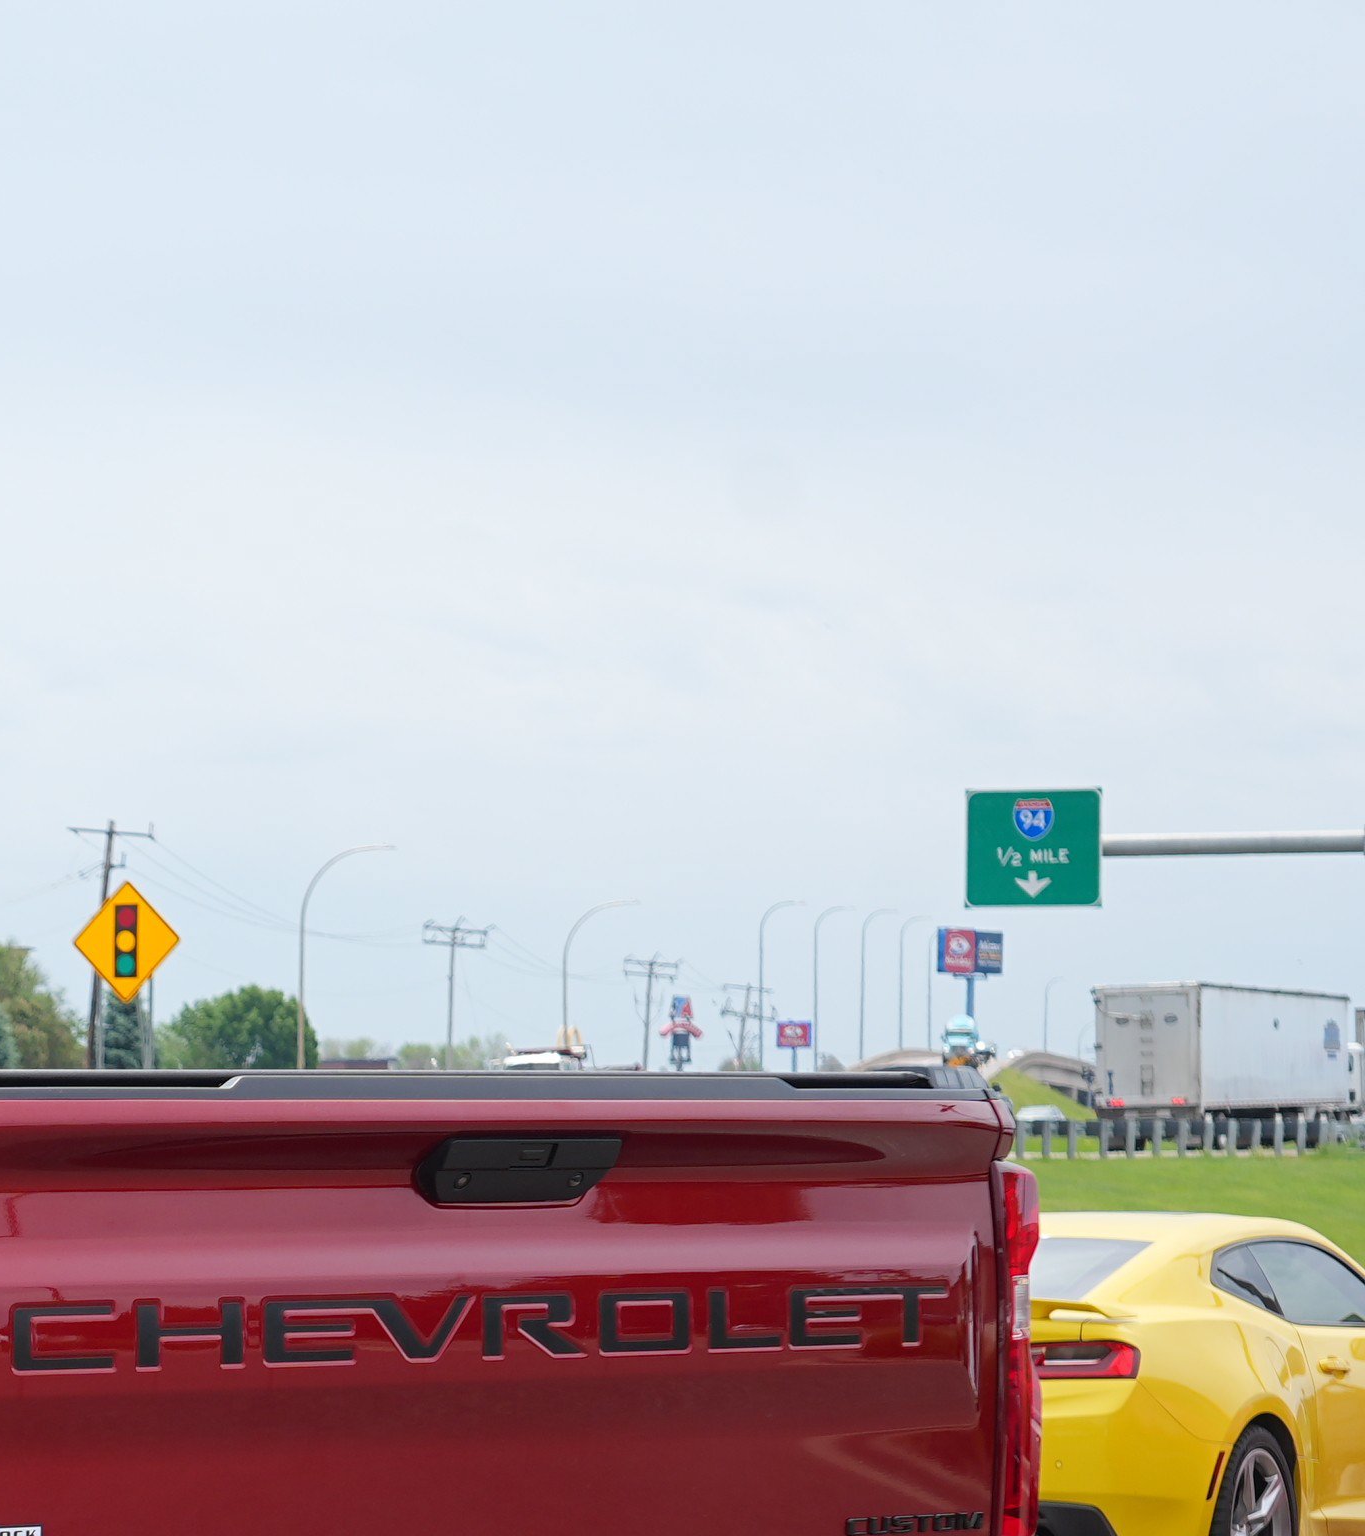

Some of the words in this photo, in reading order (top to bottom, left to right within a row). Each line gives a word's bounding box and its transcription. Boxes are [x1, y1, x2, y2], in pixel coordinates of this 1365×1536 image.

[1020, 809, 1046, 830] 94
[1030, 847, 1070, 864] MILE
[11, 1287, 950, 1375] CHEVROLET
[845, 1511, 984, 1536] CUSTOM
